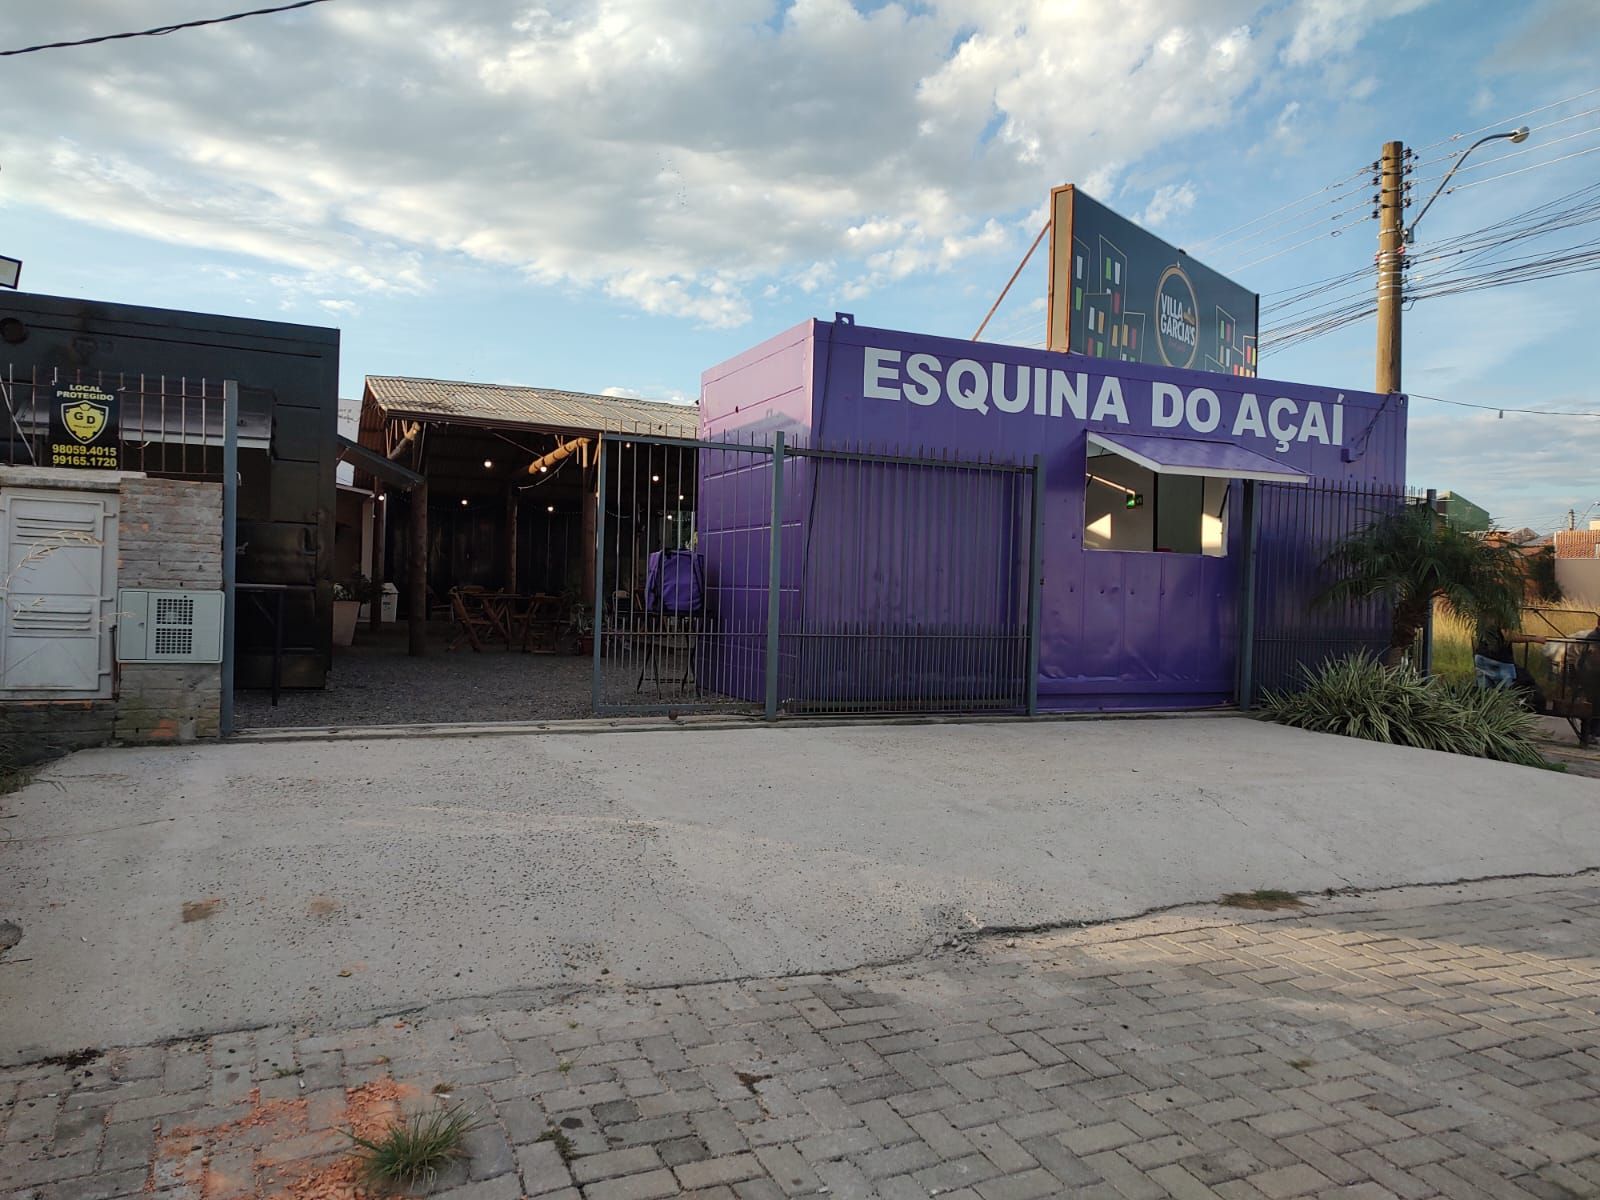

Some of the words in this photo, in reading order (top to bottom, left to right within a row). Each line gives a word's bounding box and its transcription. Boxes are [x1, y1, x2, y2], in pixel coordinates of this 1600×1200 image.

[1160, 292, 1184, 321] VILLA
[69, 384, 102, 393] LOCAL
[56, 390, 114, 401] PROTEGIDO
[863, 346, 1130, 424] ESQUINA
[1151, 381, 1221, 434] DO
[1231, 393, 1345, 453] AÇAÍ
[52, 444, 117, 456] 98059.4015
[52, 454, 117, 467] 99165.1720
